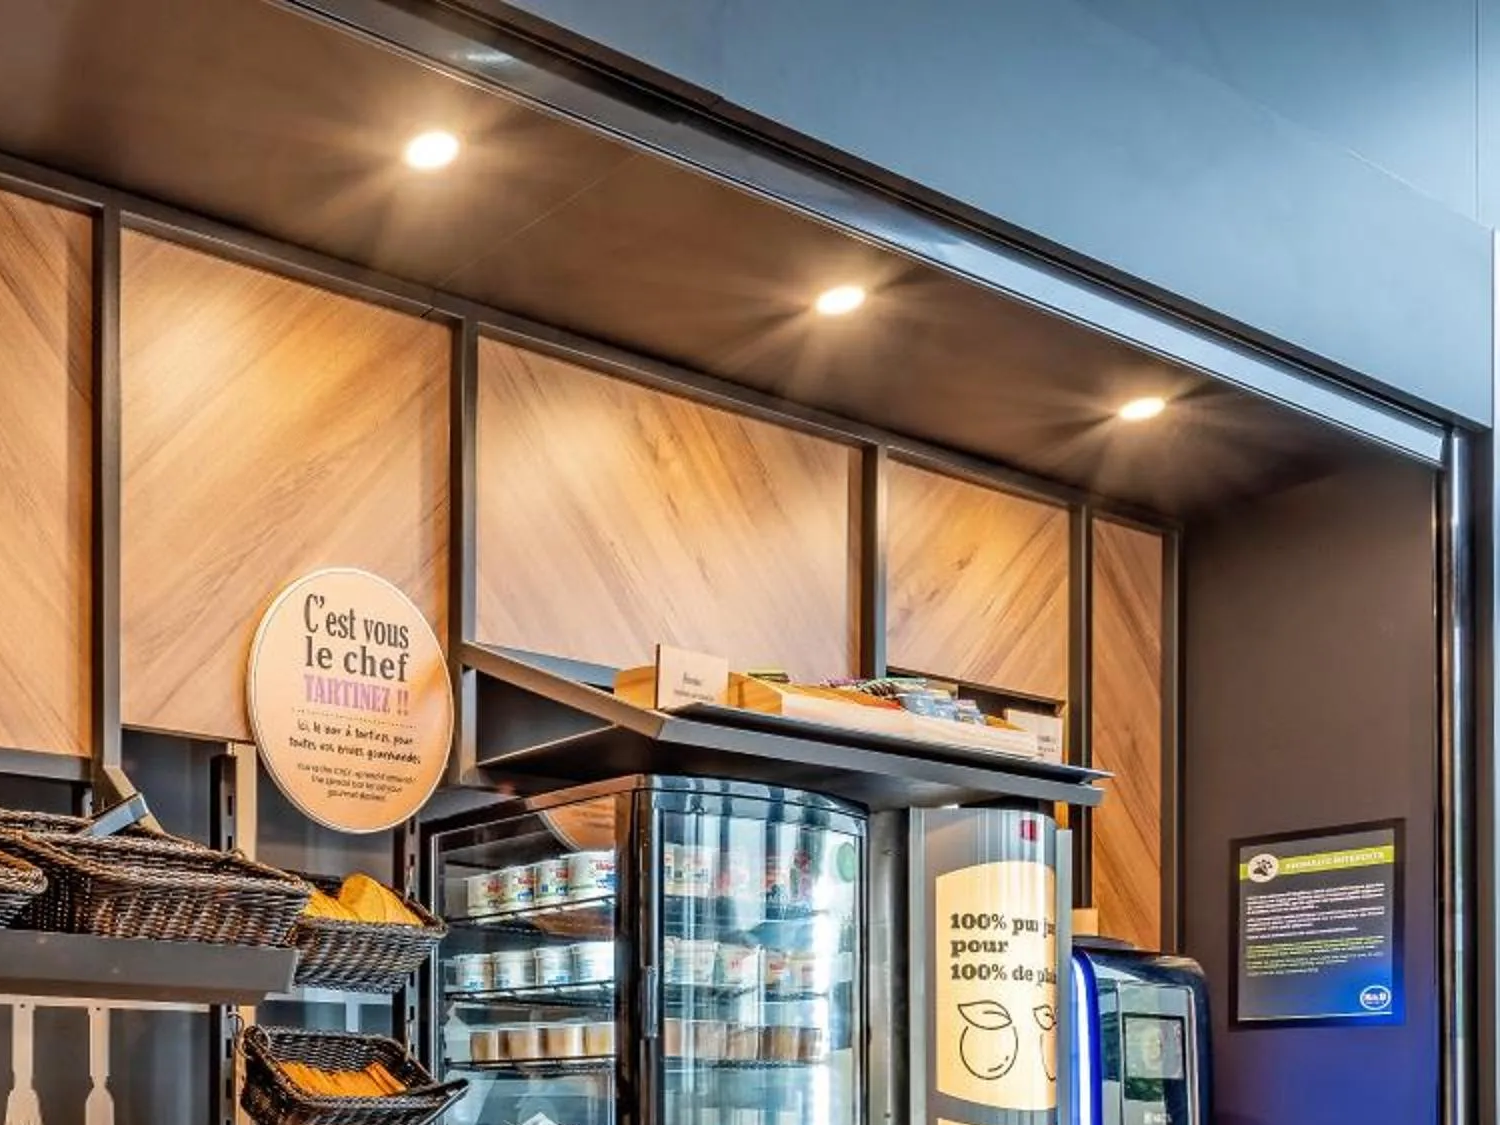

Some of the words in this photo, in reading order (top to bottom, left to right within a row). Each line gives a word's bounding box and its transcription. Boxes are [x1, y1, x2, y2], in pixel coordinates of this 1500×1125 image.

[304, 593, 356, 641] C'est
[363, 618, 409, 650] vous
[305, 635, 333, 670] le
[343, 645, 409, 682] chef
[303, 674, 391, 713] TARTINEZ
[950, 912, 1008, 930] 100%
[950, 939, 1009, 958] pour
[950, 963, 1008, 981] 100%
[1011, 964, 1033, 981] de
